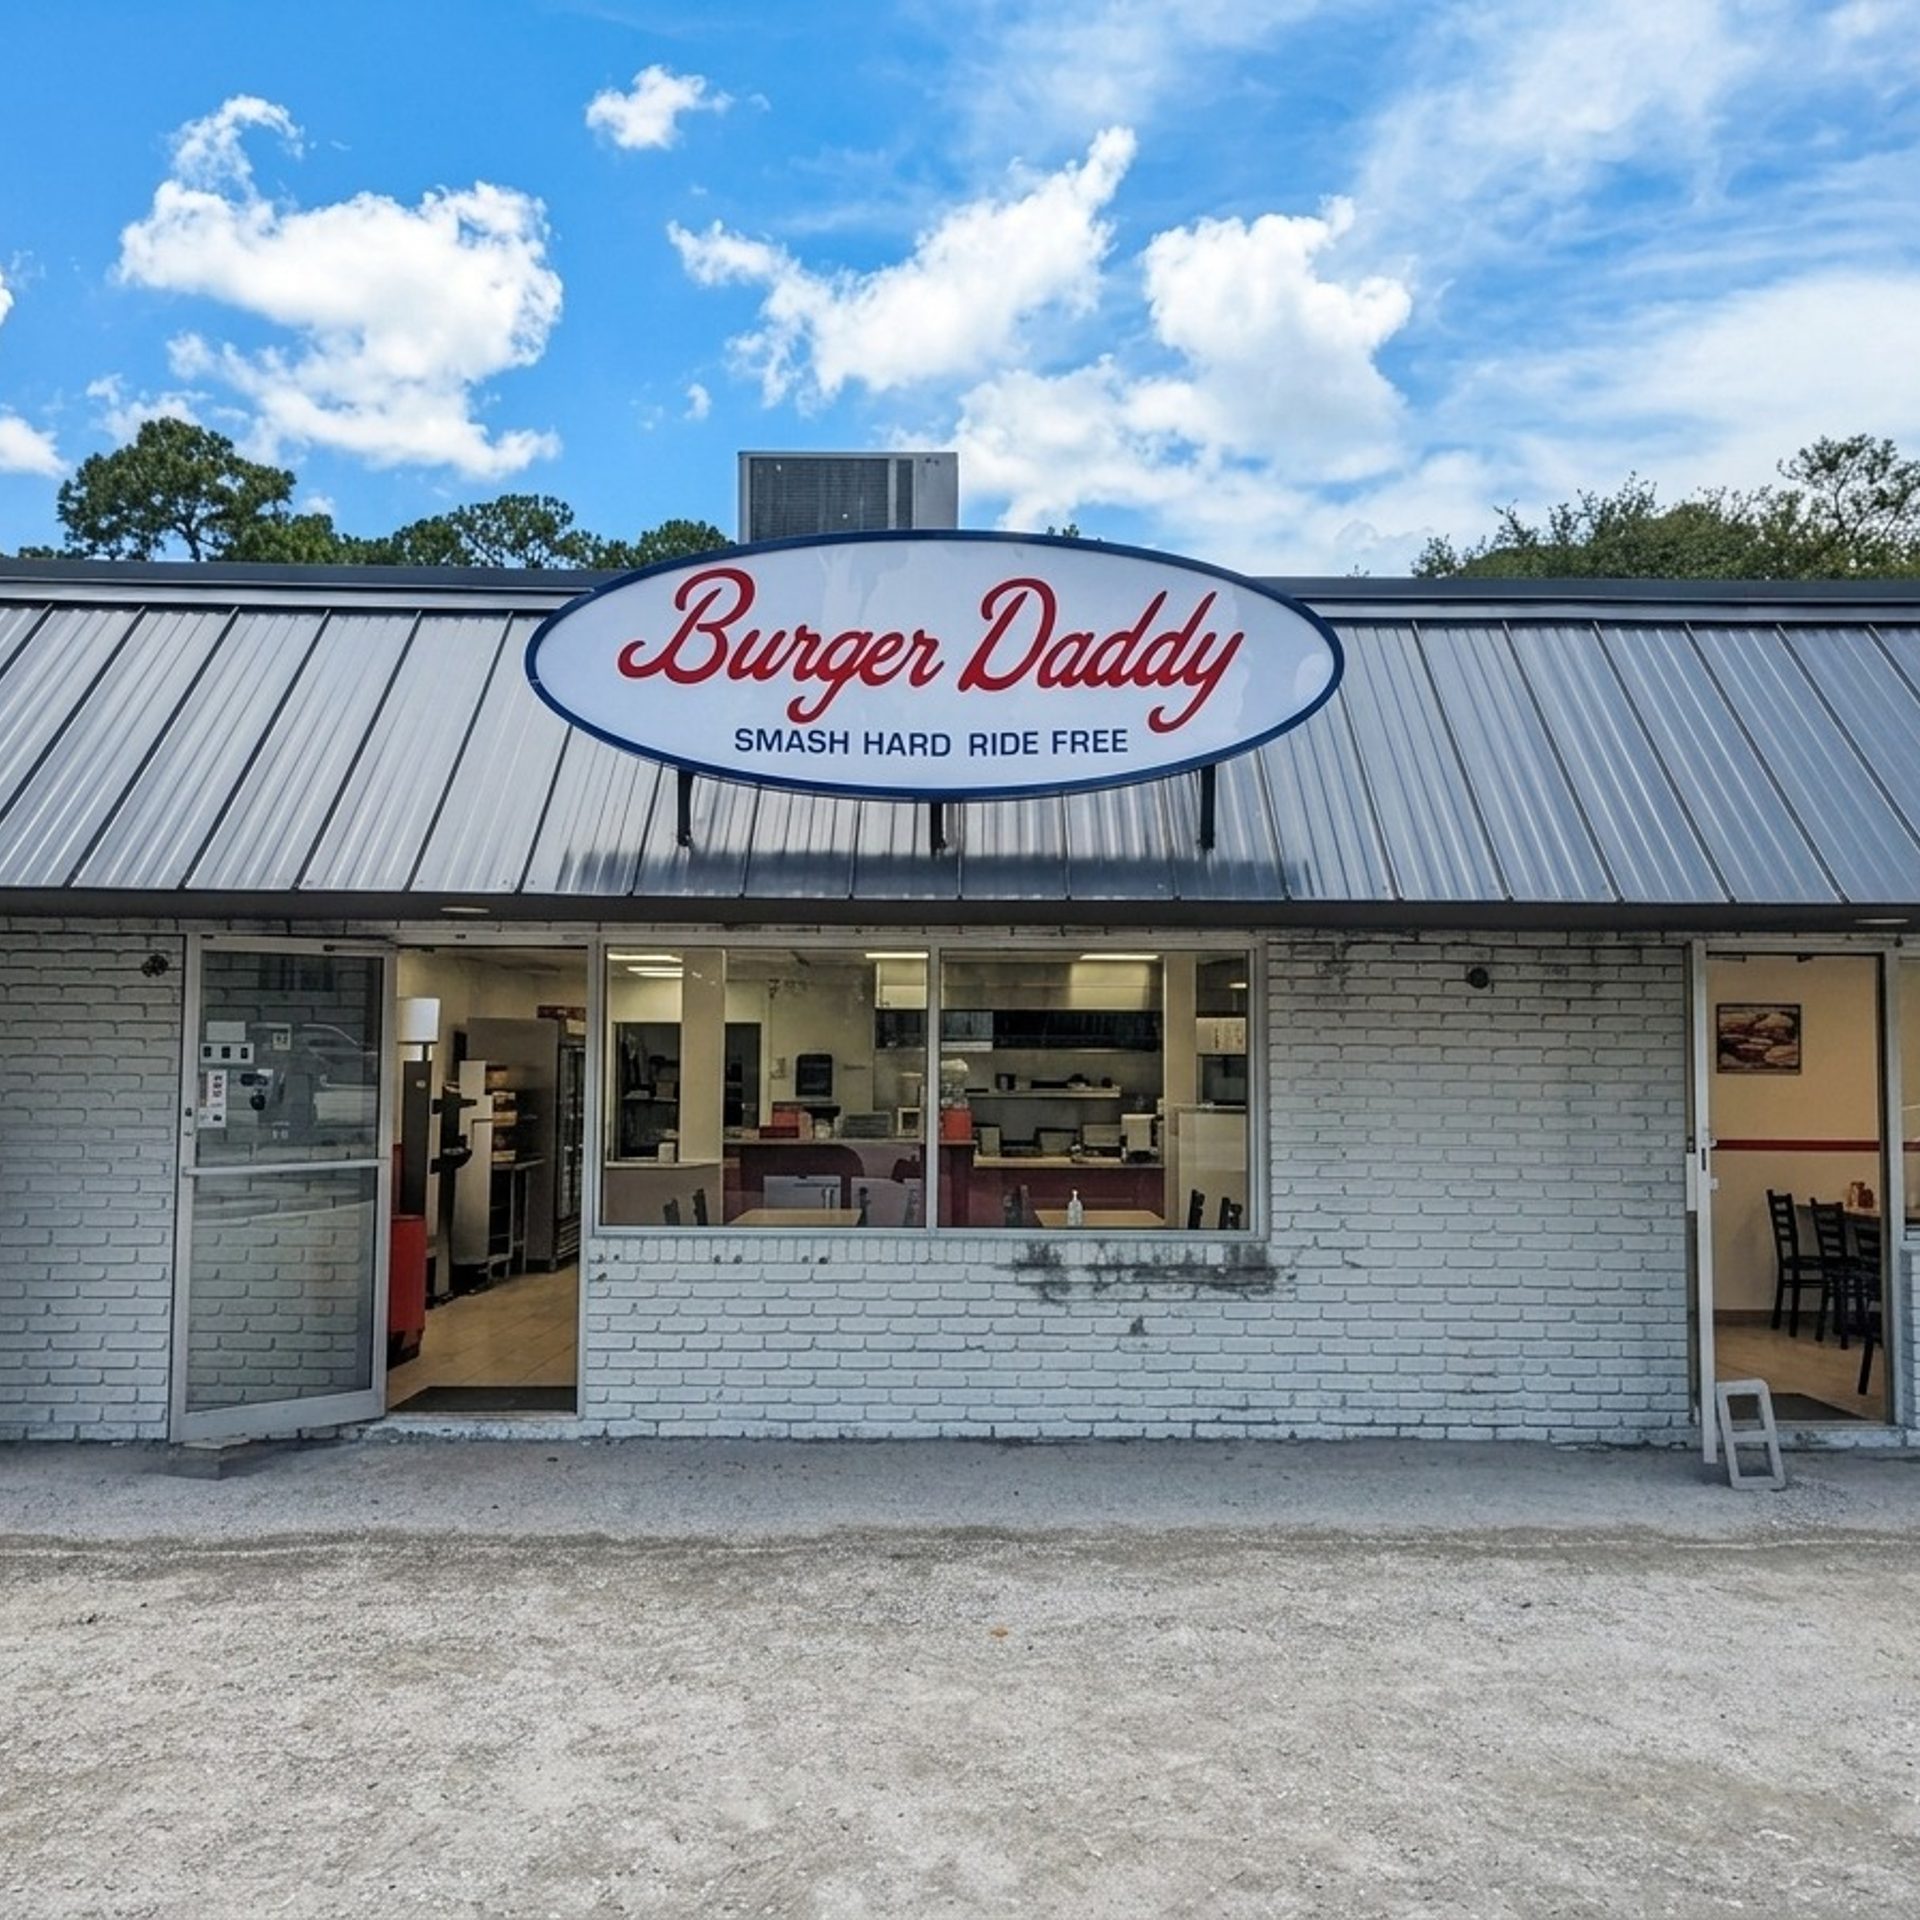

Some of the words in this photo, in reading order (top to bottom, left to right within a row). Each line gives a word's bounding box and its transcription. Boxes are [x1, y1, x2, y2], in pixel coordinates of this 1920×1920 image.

[618, 568, 943, 724] Burger
[959, 578, 1244, 733] Daddy
[734, 727, 850, 757] SMASH
[863, 730, 952, 758] HARD
[968, 730, 1039, 757] RIDE
[1051, 728, 1129, 755] FREE
